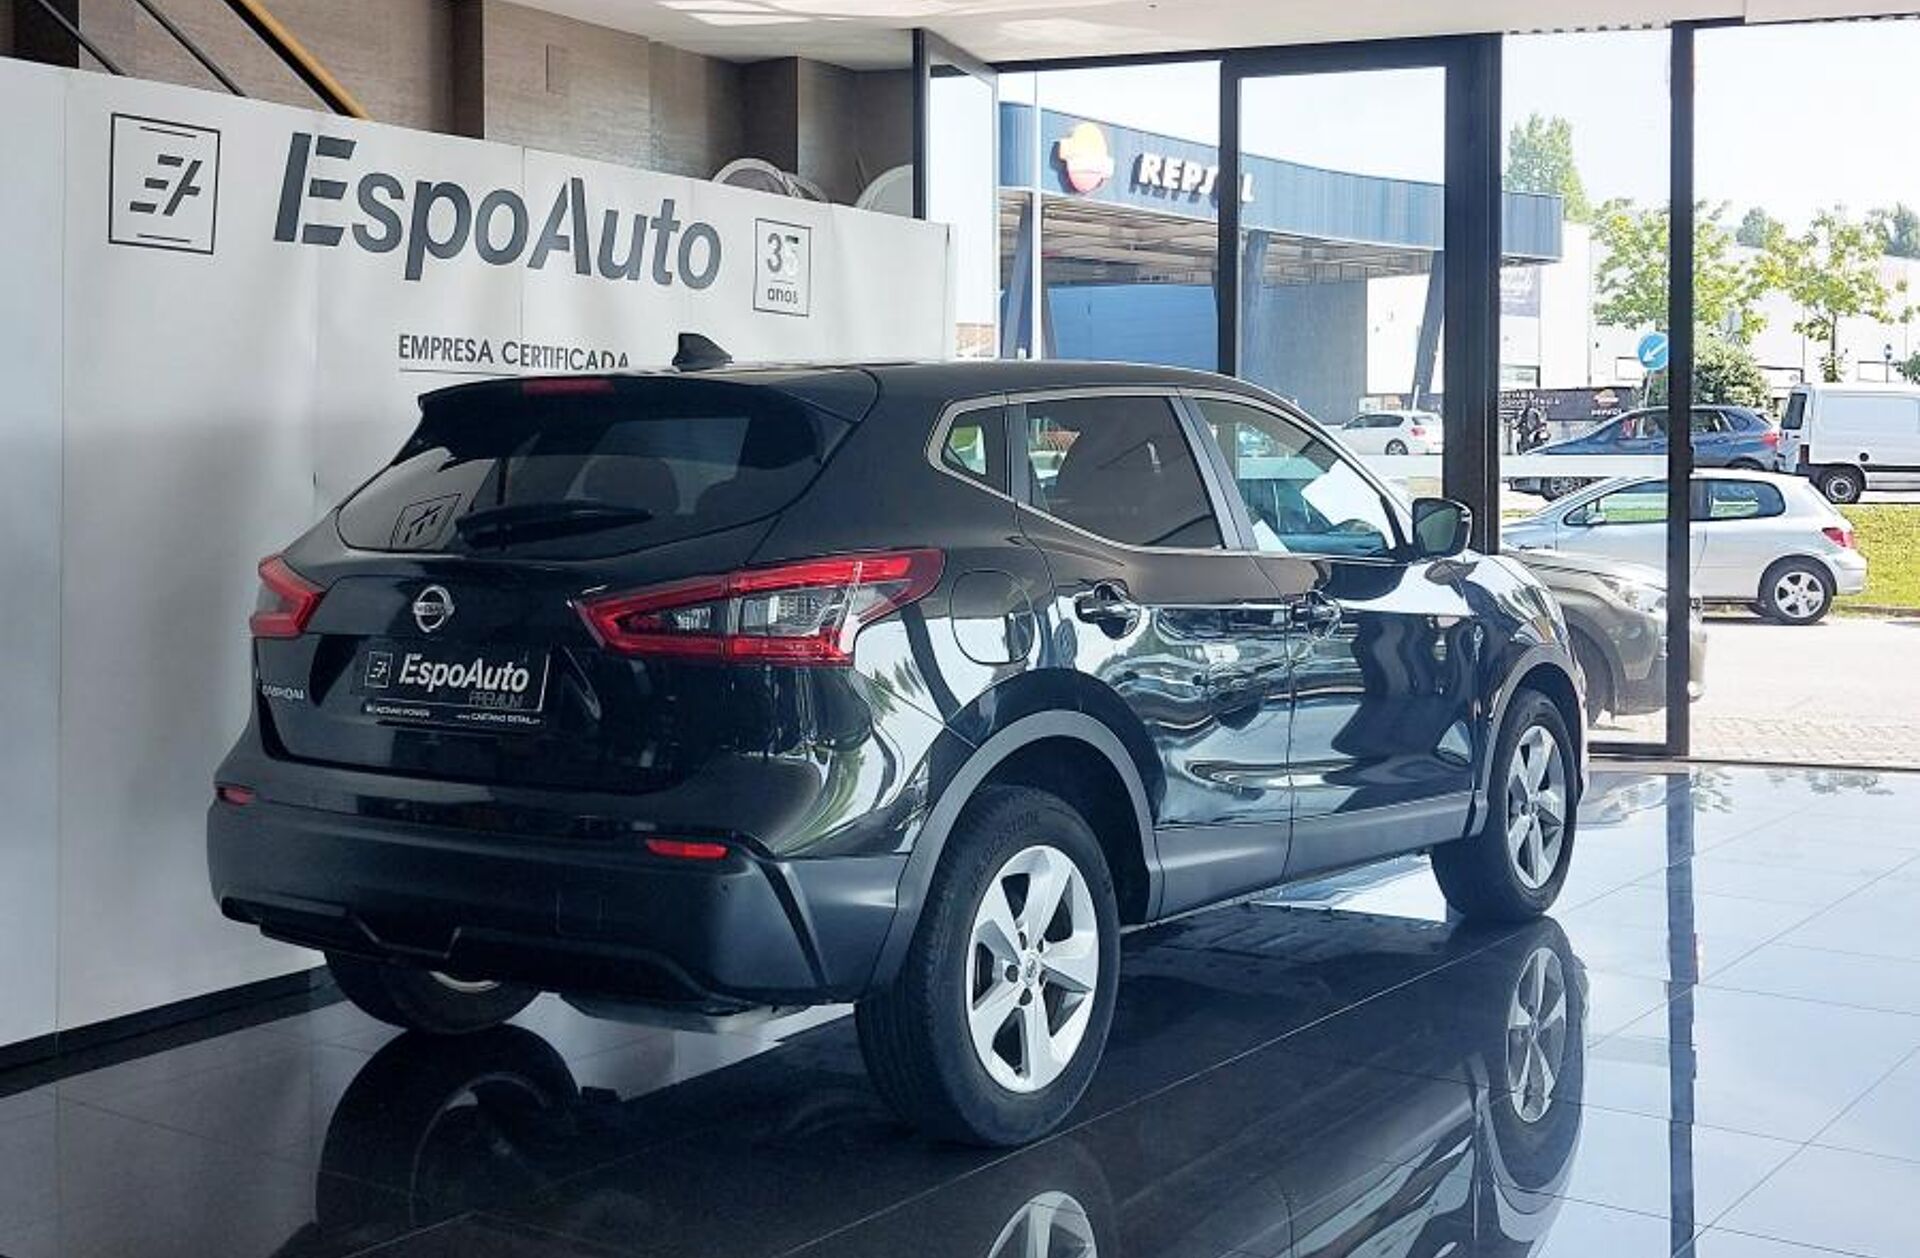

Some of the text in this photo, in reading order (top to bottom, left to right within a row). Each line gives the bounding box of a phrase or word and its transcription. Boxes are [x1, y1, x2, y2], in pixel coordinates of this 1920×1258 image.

[1138, 152, 1256, 203] REPSL
[273, 132, 722, 289] EspoAuto
[768, 287, 799, 305] anos
[399, 334, 630, 370] EMPRESA CERTIFICADA
[399, 653, 530, 693] EspoAuto
